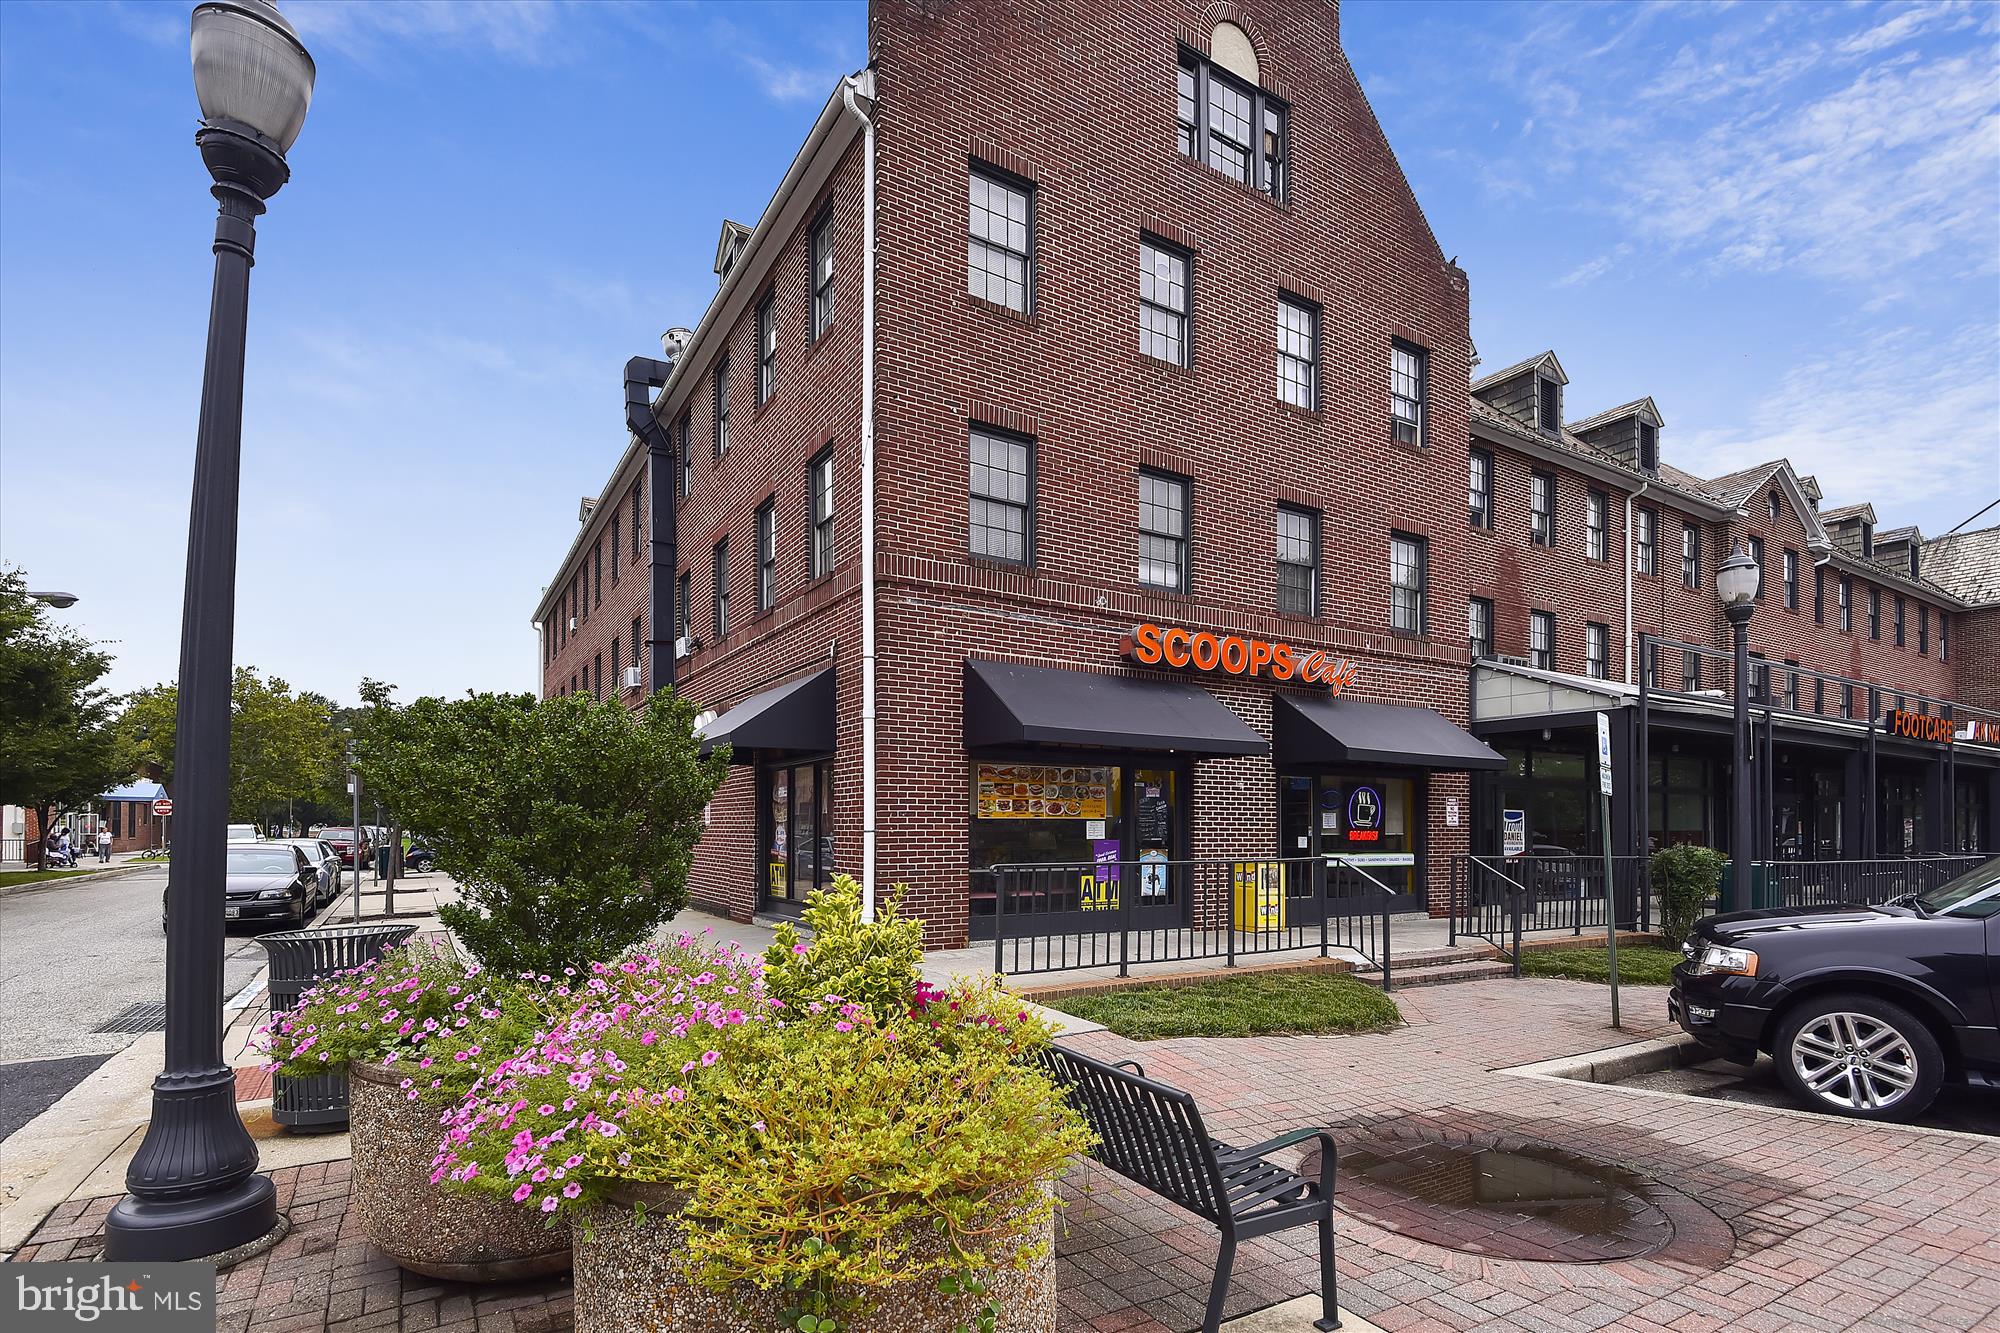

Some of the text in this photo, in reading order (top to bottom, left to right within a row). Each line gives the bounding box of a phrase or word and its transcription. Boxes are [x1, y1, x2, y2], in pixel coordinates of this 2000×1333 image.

[1135, 623, 1358, 697] SCOOPS Café
[1894, 708, 1952, 743] FOOTCARE
[1349, 830, 1379, 841] BREAKFAST
[1081, 878, 1118, 900] ATM
